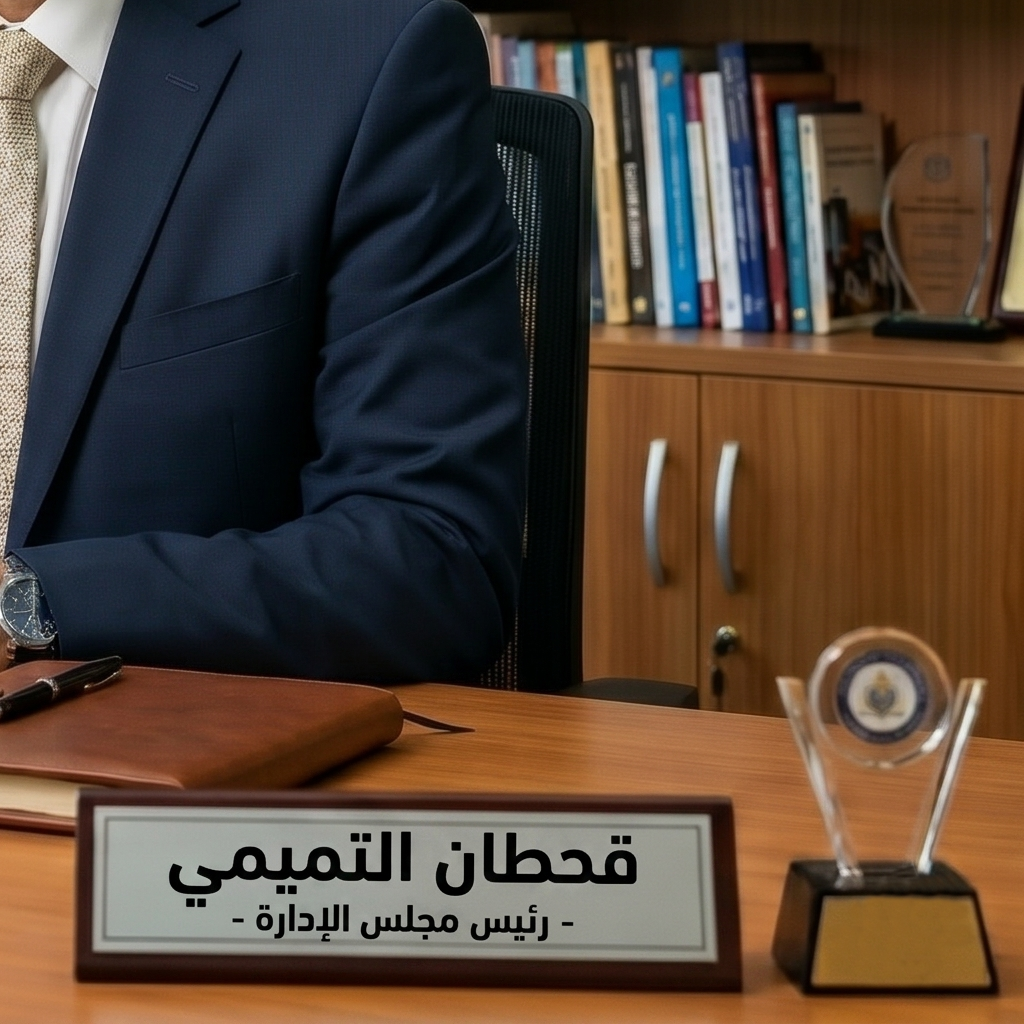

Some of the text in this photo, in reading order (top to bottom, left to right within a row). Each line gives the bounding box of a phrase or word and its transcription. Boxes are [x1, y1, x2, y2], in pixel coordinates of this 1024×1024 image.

[168, 831, 638, 908] قحطان التميمي
[255, 903, 350, 943] الإدارة
[360, 904, 459, 940] مجلس
[470, 904, 549, 942] رئيس
